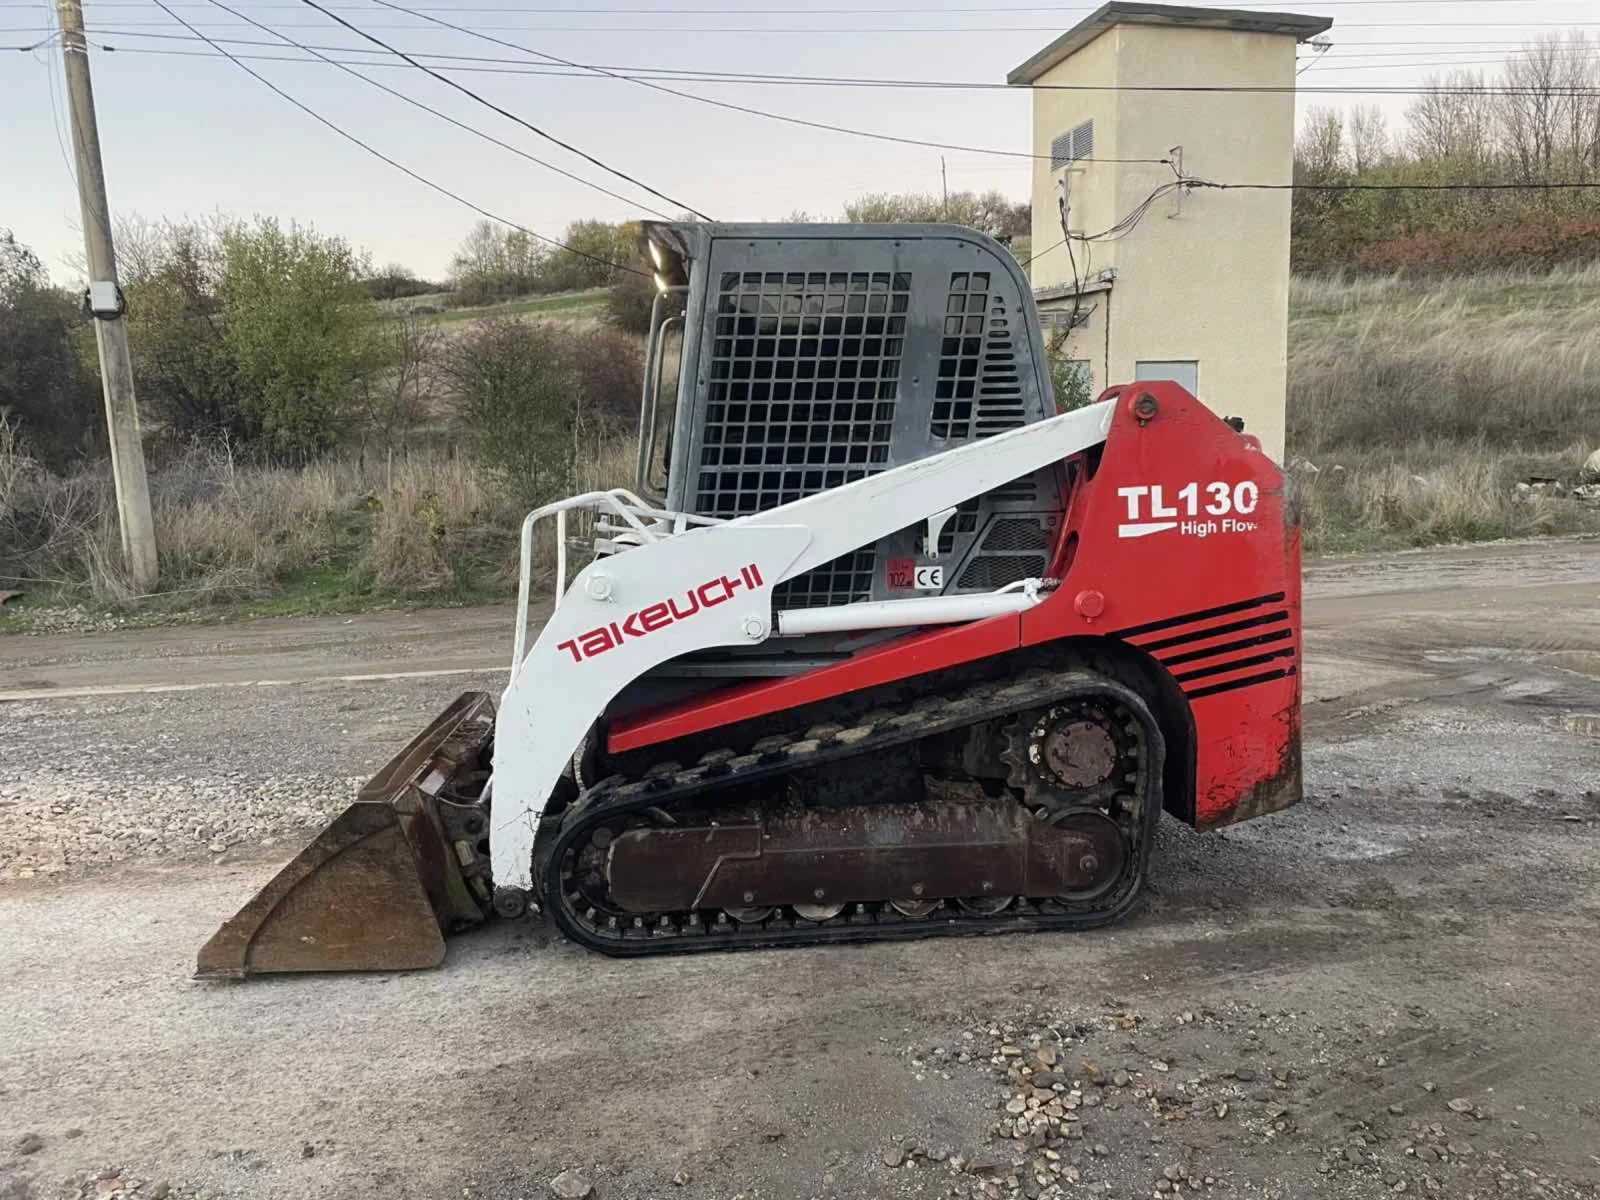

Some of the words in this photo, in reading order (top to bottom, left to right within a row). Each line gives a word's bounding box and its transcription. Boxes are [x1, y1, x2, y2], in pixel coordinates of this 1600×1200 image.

[1117, 481, 1259, 520] TL130
[1180, 521, 1218, 538] High
[917, 569, 940, 586] CE
